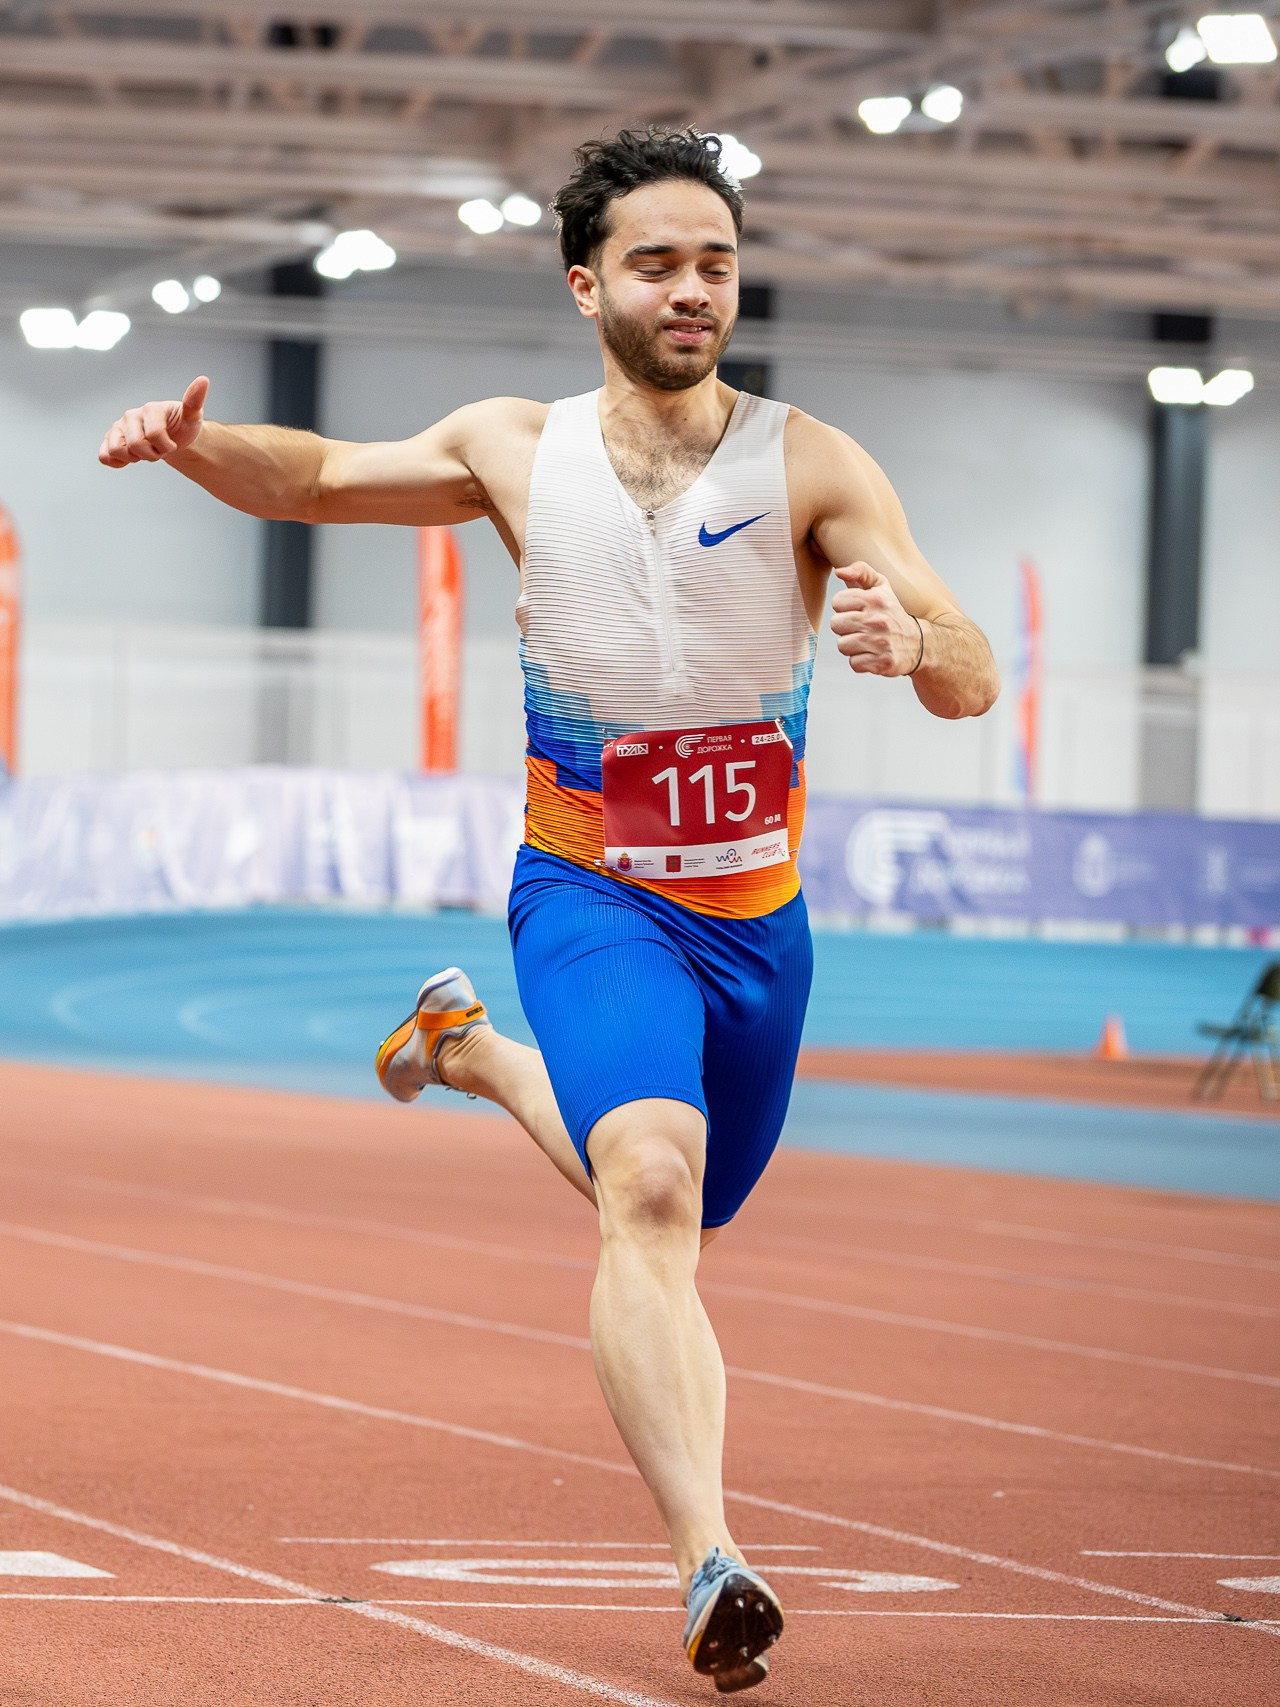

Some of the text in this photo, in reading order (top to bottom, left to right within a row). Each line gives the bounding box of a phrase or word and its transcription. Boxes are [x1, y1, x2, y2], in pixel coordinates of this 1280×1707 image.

[707, 734, 733, 743] ПЕРВАЯ
[697, 744, 733, 754] ДОРОЖКА
[651, 760, 757, 827] 115
[764, 815, 774, 825] 60
